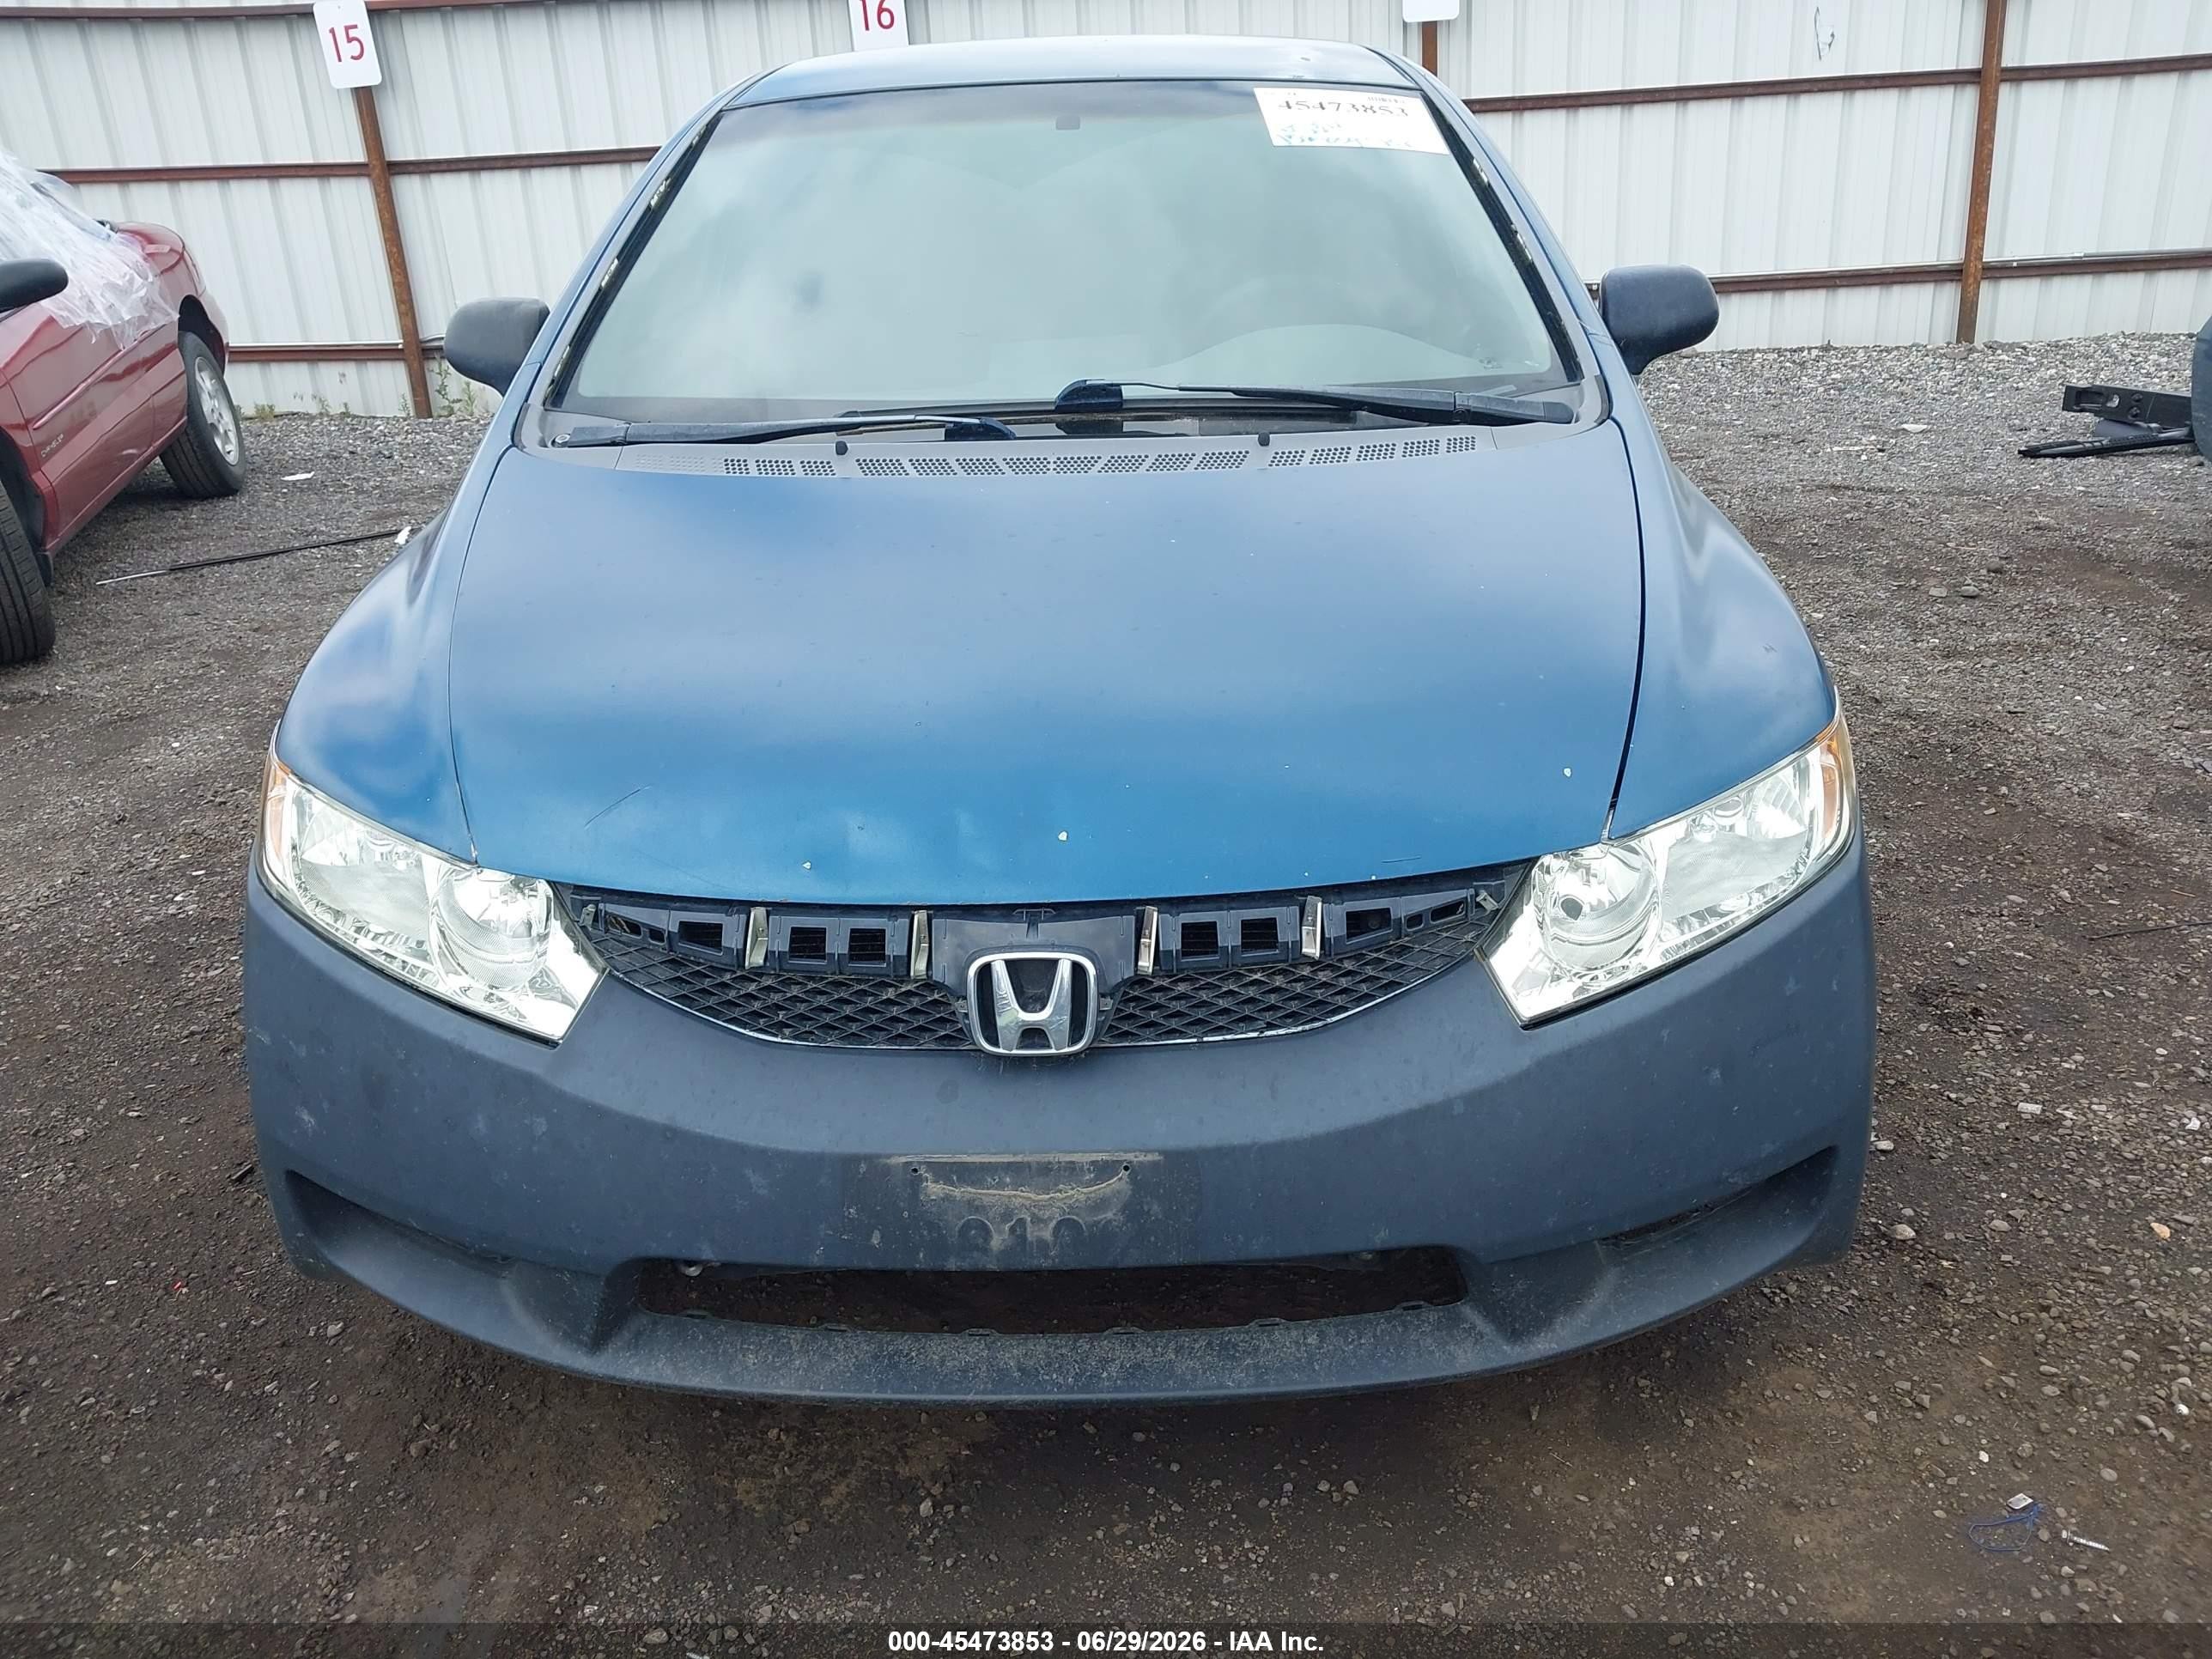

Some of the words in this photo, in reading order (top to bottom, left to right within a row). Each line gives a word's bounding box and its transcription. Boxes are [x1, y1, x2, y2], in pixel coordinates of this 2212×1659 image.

[859, 0, 895, 31] 16
[328, 23, 365, 63] 15
[1276, 99, 1409, 118] 45473853
